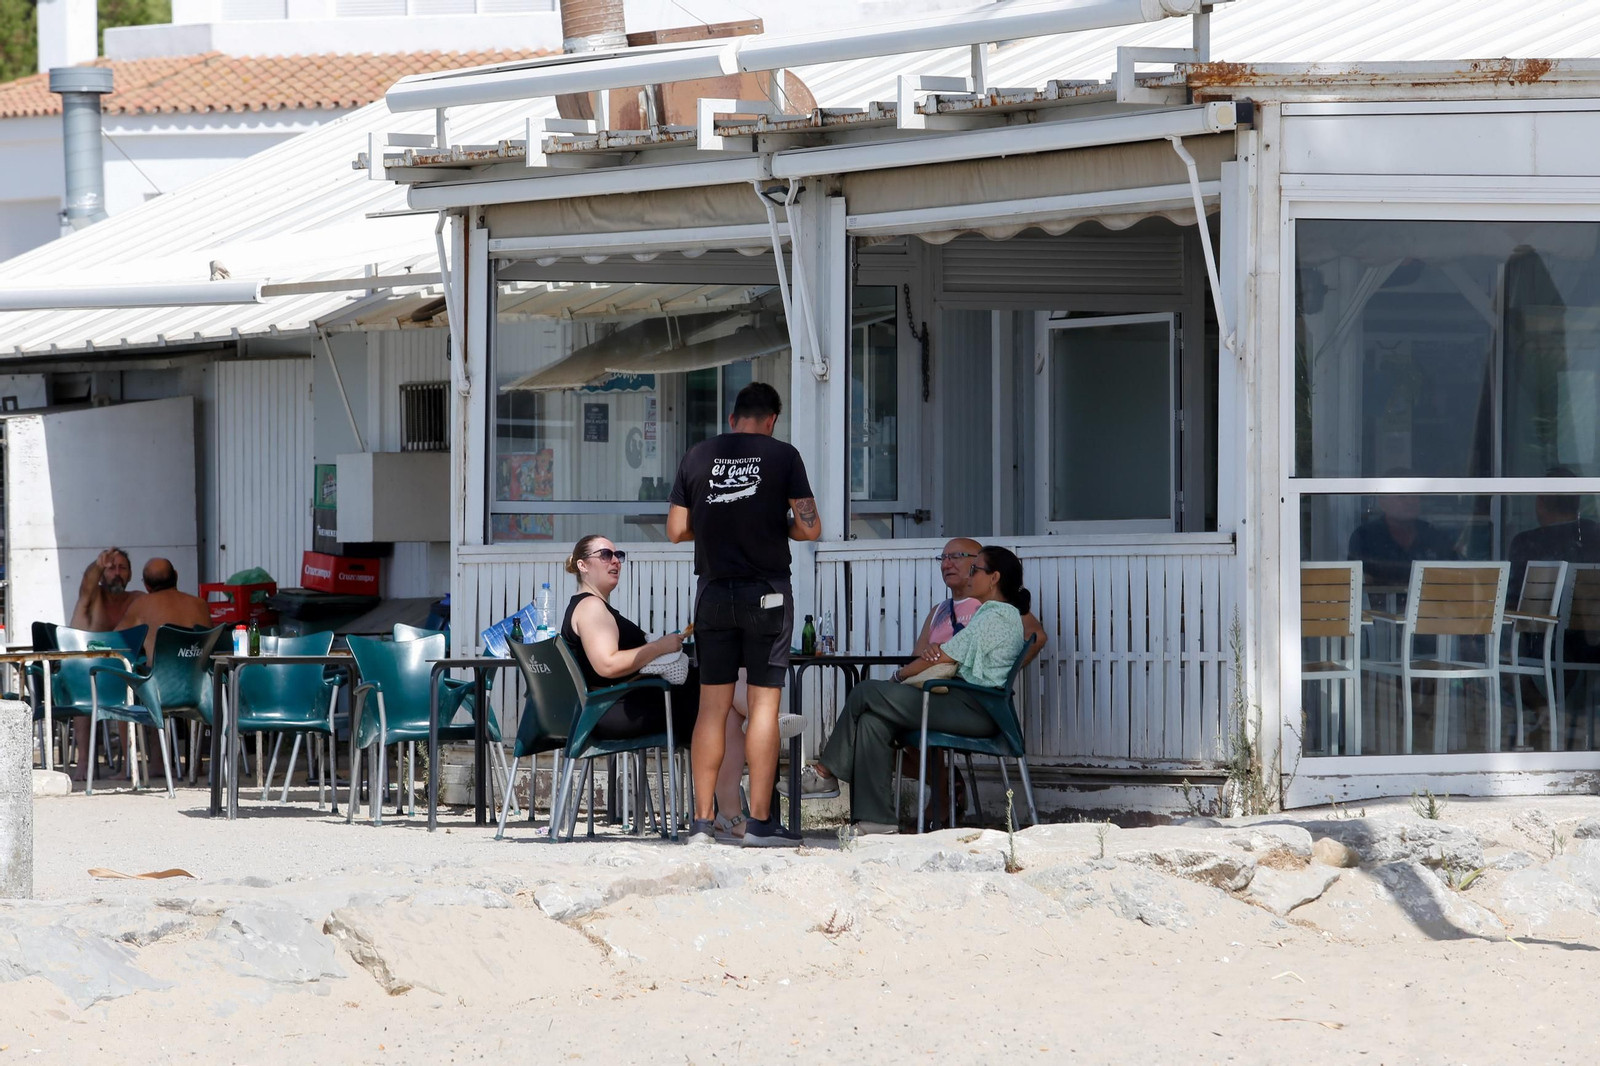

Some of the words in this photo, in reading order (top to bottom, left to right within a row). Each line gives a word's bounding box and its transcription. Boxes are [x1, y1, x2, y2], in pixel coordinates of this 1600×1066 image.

[713, 457, 761, 465] CHIRINGUITO
[711, 464, 726, 476] El
[728, 463, 760, 479] Garito
[338, 572, 375, 582] Cruzcampo
